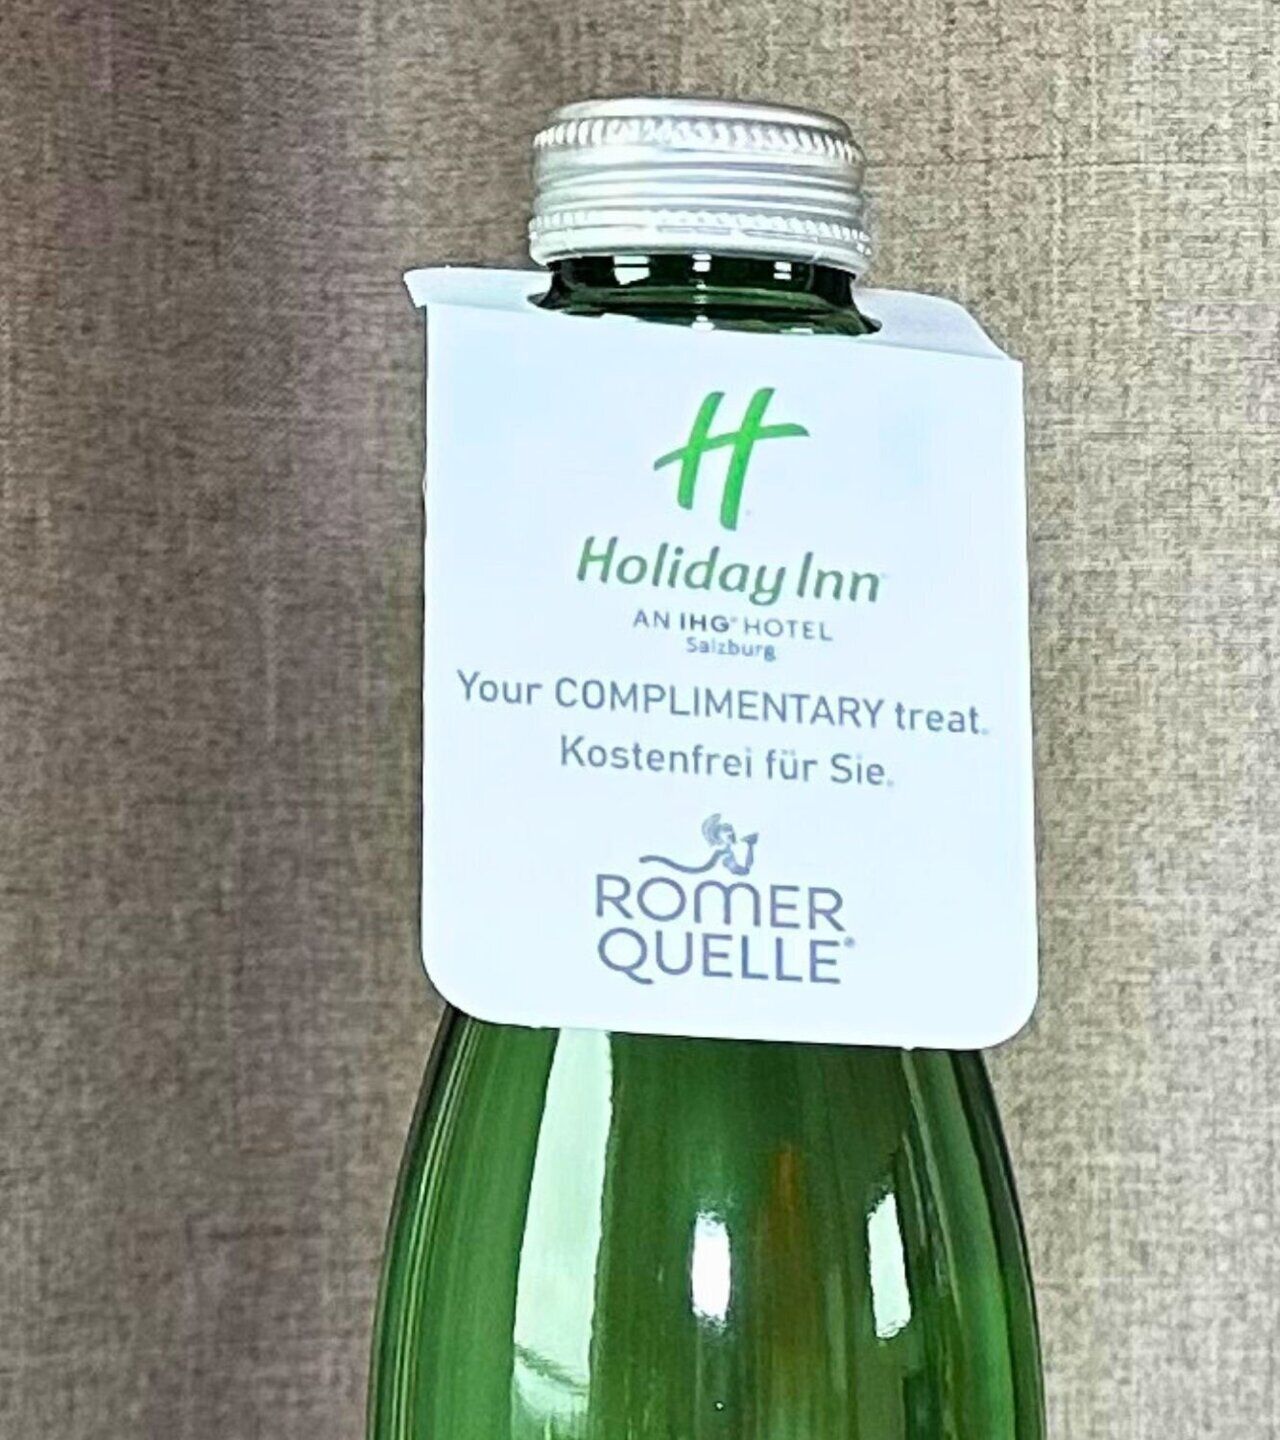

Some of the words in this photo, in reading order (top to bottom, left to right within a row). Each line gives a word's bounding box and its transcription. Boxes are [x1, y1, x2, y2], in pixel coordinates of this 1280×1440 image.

[575, 535, 787, 607] Holiday
[796, 551, 881, 604] Inn
[632, 608, 671, 630] AN
[743, 617, 834, 642] HOTEL
[686, 636, 777, 663] Salzburg
[456, 668, 544, 706] Your
[554, 676, 885, 730] COMPLIMENTARY
[894, 701, 990, 736] treat.
[560, 734, 752, 779] Kostenfrei
[765, 748, 819, 783] für
[830, 752, 895, 788] Sie.
